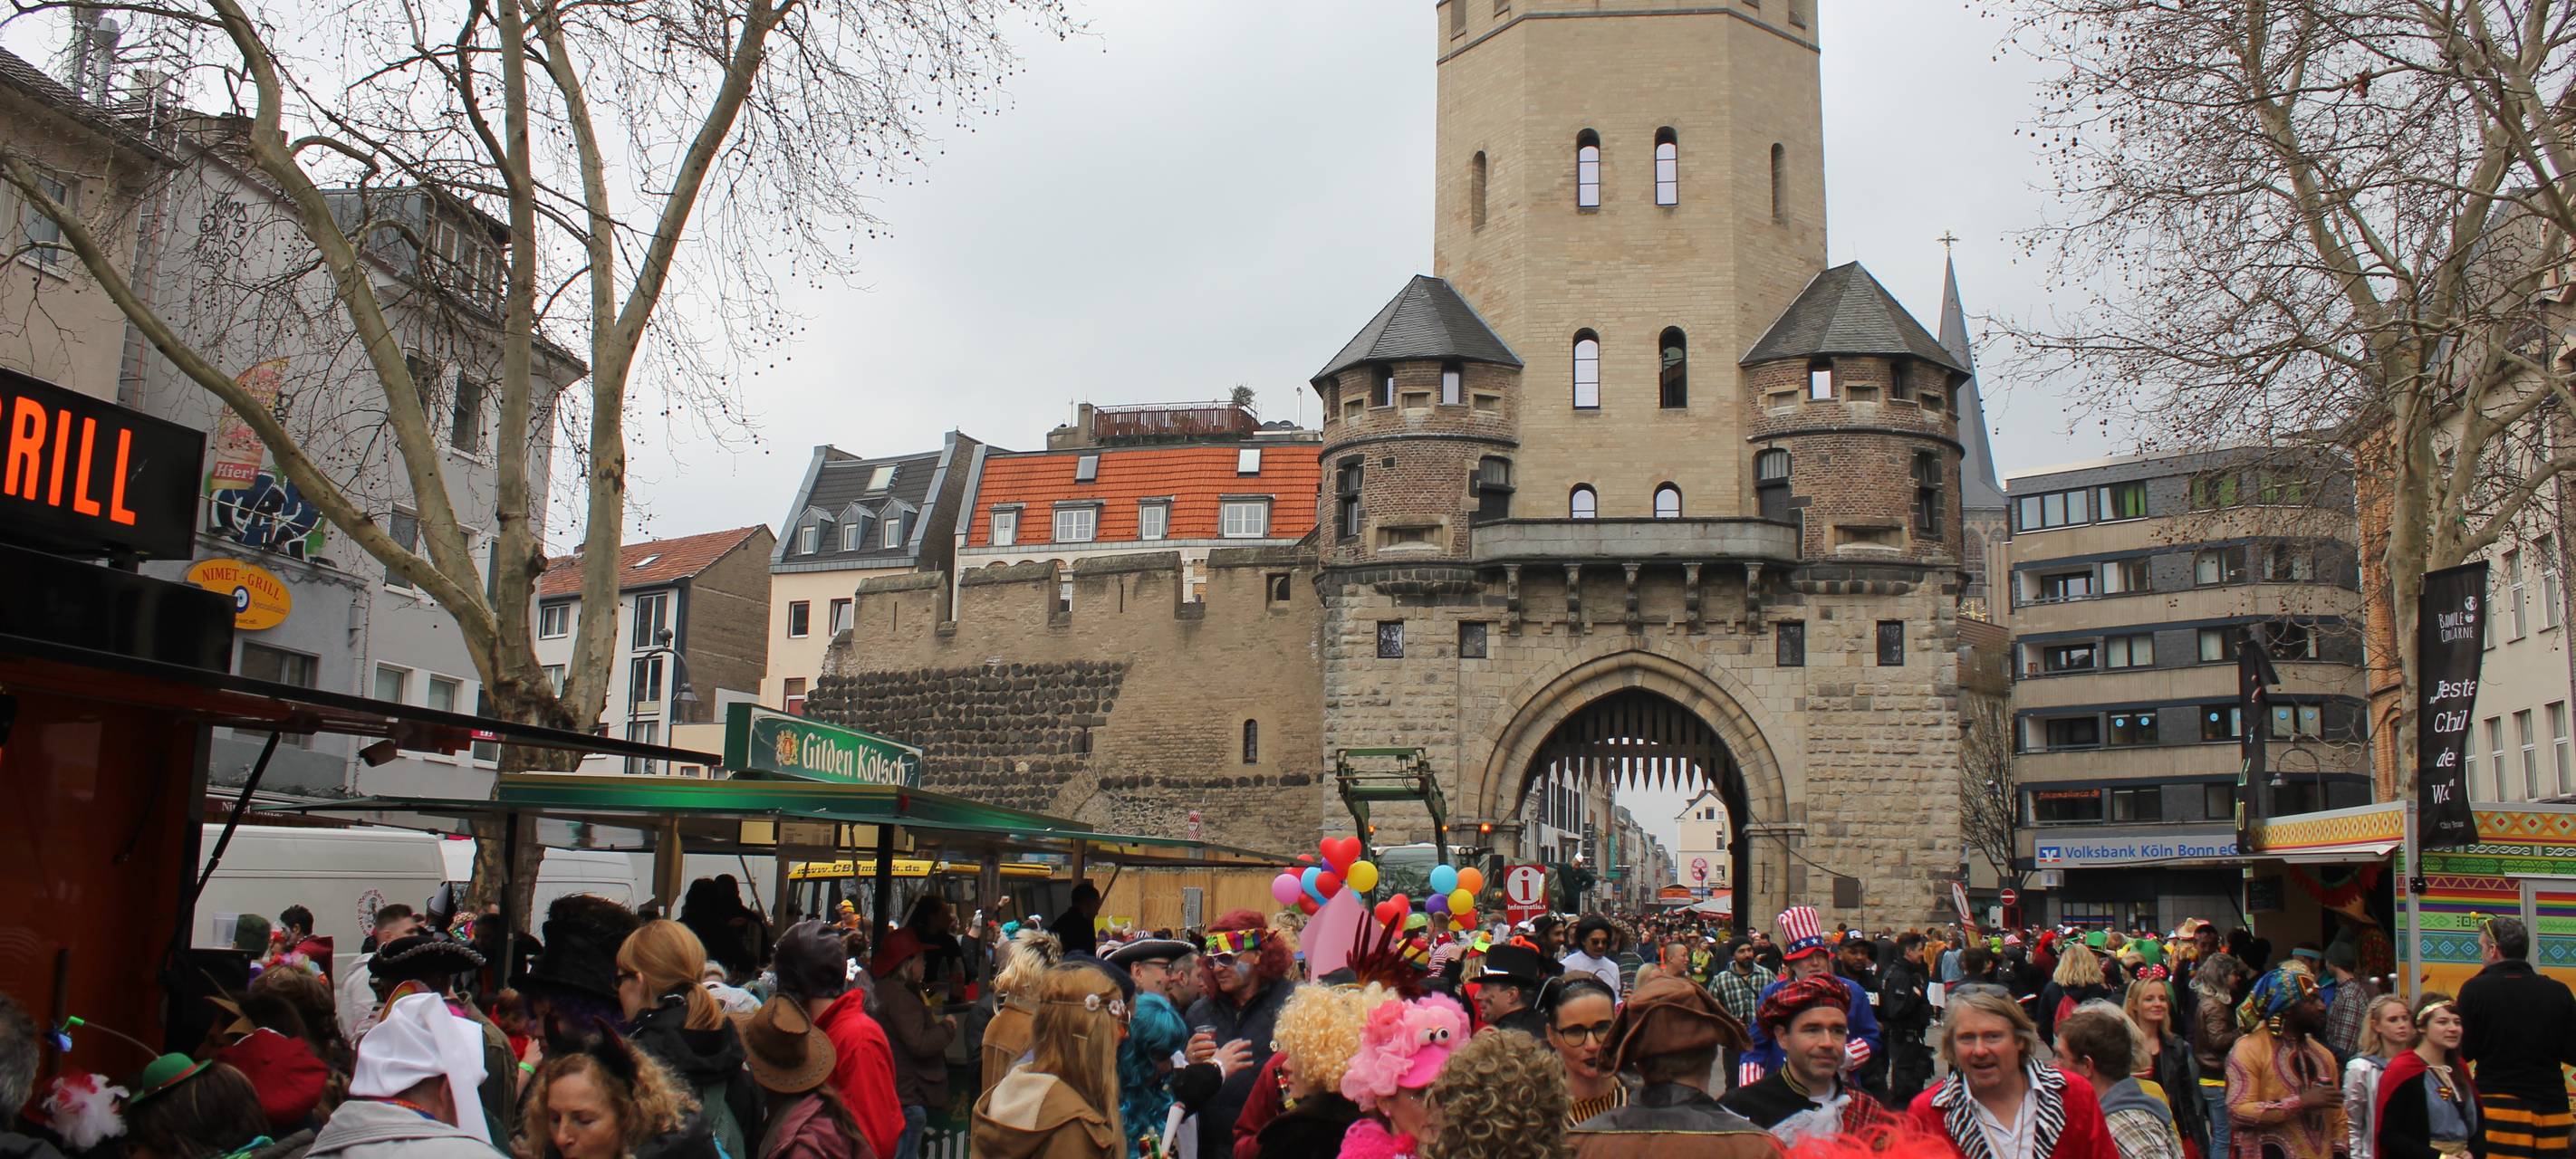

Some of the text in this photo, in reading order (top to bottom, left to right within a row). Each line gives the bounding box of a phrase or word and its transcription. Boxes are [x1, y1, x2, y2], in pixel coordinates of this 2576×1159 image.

[0, 395, 137, 526] RILL
[215, 464, 256, 480] Hier!
[202, 567, 239, 582] NIMET
[247, 572, 280, 601] GRILL
[2434, 710, 2467, 733] Chil
[802, 732, 905, 786] Gilden Kölsch
[2437, 747, 2456, 768] de
[2065, 842, 2239, 858] Volksbank Köln Bonn eG
